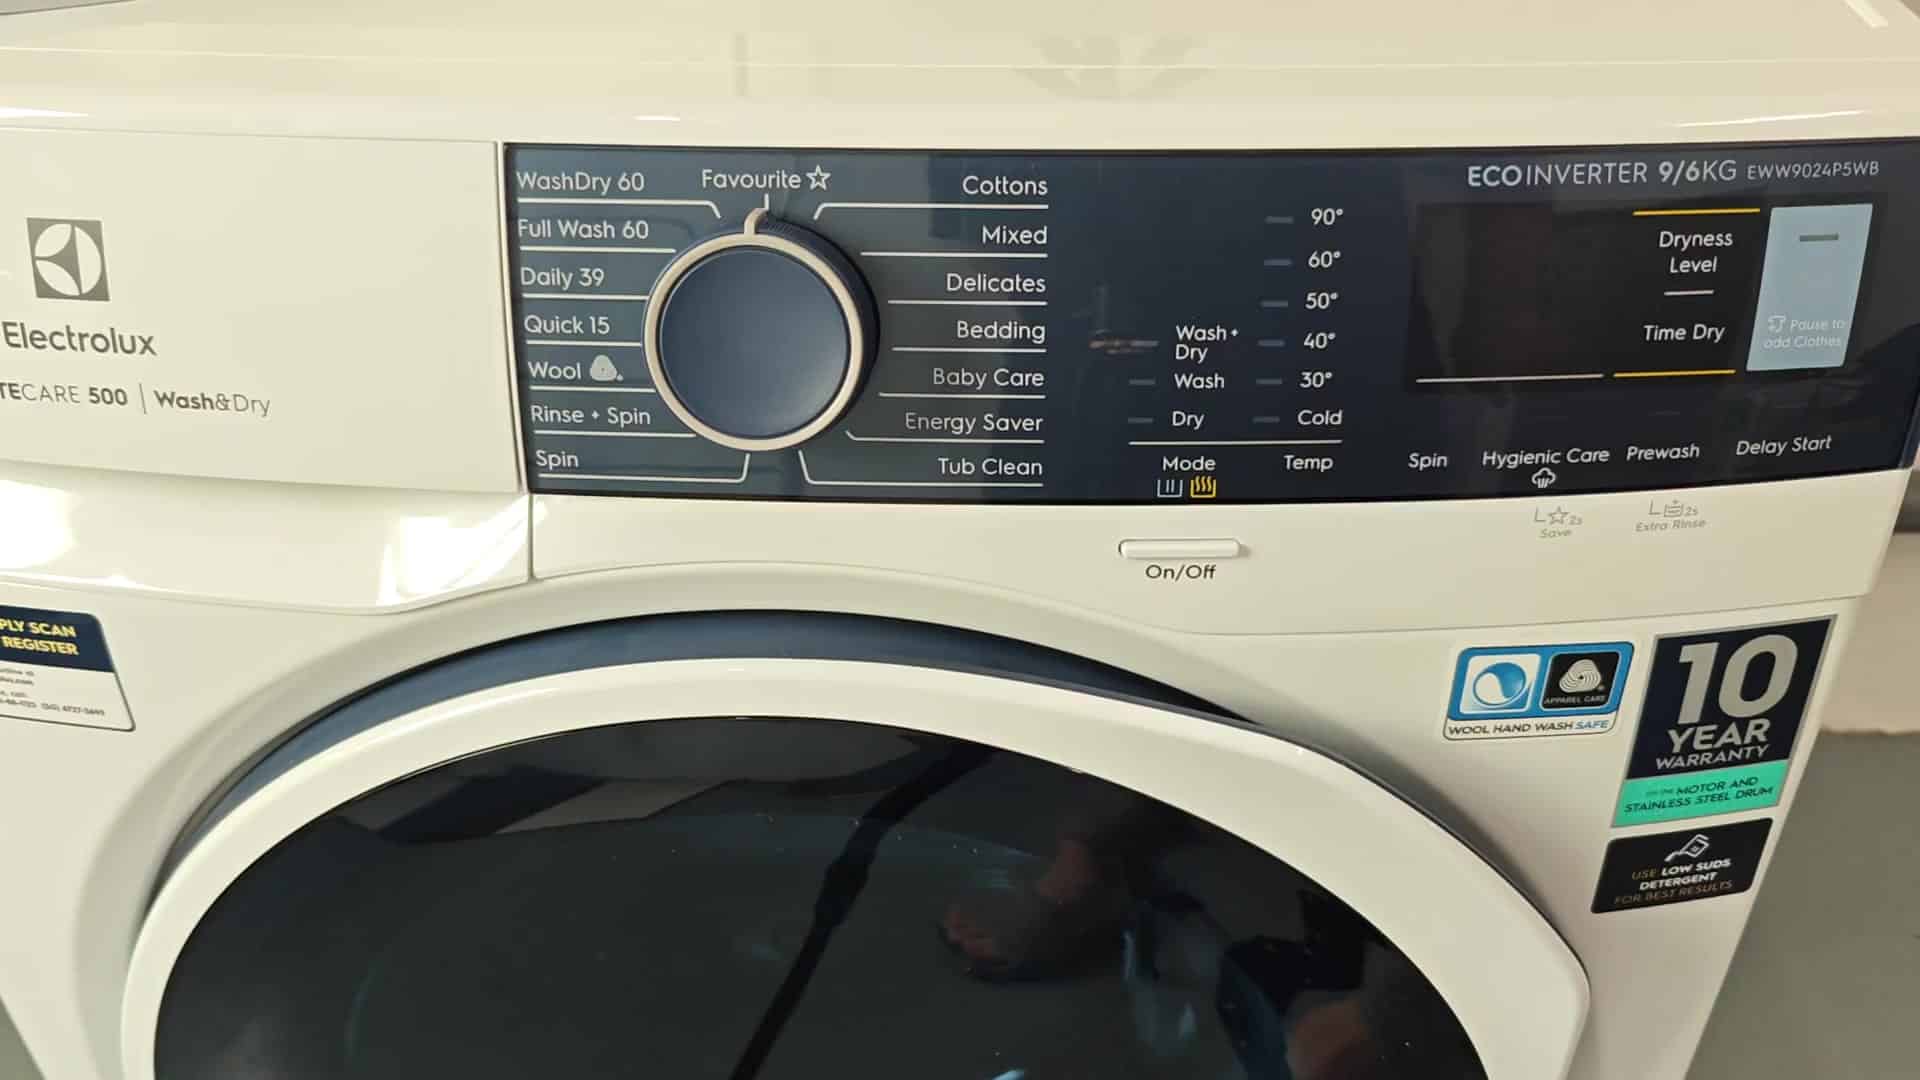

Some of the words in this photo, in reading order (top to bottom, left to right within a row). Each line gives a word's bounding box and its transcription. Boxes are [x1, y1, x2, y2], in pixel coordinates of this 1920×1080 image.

[701, 169, 802, 189] Favourite
[1467, 162, 1648, 187] ECOINVERTER
[1658, 159, 1738, 186] 9/6KG
[1746, 160, 1880, 181] EWW9024P5WB
[516, 172, 612, 196] WashDry
[617, 172, 645, 191] 60
[962, 175, 1048, 196] Cottons
[518, 219, 551, 239] Full
[558, 219, 616, 239] Wash
[622, 220, 649, 240] 60
[981, 225, 1048, 246] Mixed
[1658, 231, 1733, 251] Dryness
[1669, 256, 1718, 275] Level
[520, 267, 573, 290] Daily
[579, 268, 605, 287] 39
[946, 273, 1047, 294] Delicates
[524, 315, 583, 335] Quick
[589, 317, 610, 335] 15
[956, 321, 1046, 345] Bedding
[1643, 324, 1686, 342] Time
[1692, 324, 1725, 344] Dry
[2, 321, 157, 356] Electrolux
[1175, 344, 1208, 363] Dry
[528, 362, 581, 380] Wool
[933, 368, 987, 390] Baby
[993, 368, 1045, 387] Care
[1174, 373, 1225, 389] Wash
[88, 386, 128, 406] 500
[154, 389, 271, 417] Wash&Dry
[531, 406, 585, 424] Rinse
[607, 407, 650, 429] Spin
[905, 412, 976, 434] Energy
[983, 413, 1043, 432] Saver
[1172, 411, 1205, 430] Dry
[1297, 410, 1342, 426] Cold
[1626, 443, 1700, 463] Prewash
[1736, 439, 1787, 459] Delay
[1792, 435, 1832, 453] Start
[535, 451, 579, 472] Spin
[938, 457, 975, 476] Tub
[982, 459, 1043, 476] Clean
[1162, 456, 1216, 472] Mode
[1284, 455, 1333, 473] Temp
[1408, 452, 1448, 472] Spin
[1482, 449, 1561, 470] Hygienic
[1566, 447, 1610, 464] Care
[1540, 527, 1572, 539] Save
[1635, 521, 1668, 533] Extra
[1672, 517, 1706, 530] Rinse
[1145, 564, 1216, 584] On/Off
[29, 622, 77, 638] SCAN
[2, 636, 79, 656] REGISTER
[1676, 634, 1798, 726] 10
[1449, 725, 1490, 736] WOOL
[1492, 723, 1532, 735] HAND
[1536, 721, 1574, 733] WASH
[1575, 719, 1609, 730] SAFE
[1668, 717, 1771, 753] YEAR
[1655, 743, 1770, 771] WARRANTY
[1676, 781, 1726, 796] MOTOR
[1730, 776, 1759, 789] AND
[1623, 797, 1691, 814] STAINLESS
[1695, 791, 1730, 805] STEEL
[1735, 787, 1774, 800] DRUM
[1631, 868, 1658, 881] USE
[1661, 862, 1692, 876] LOW
[1695, 857, 1732, 871] SUDS
[1639, 871, 1718, 891] DETERGENT
[1614, 894, 1642, 905] FOR
[1645, 888, 1675, 901] BEST
[1678, 879, 1733, 898] RESULTS
